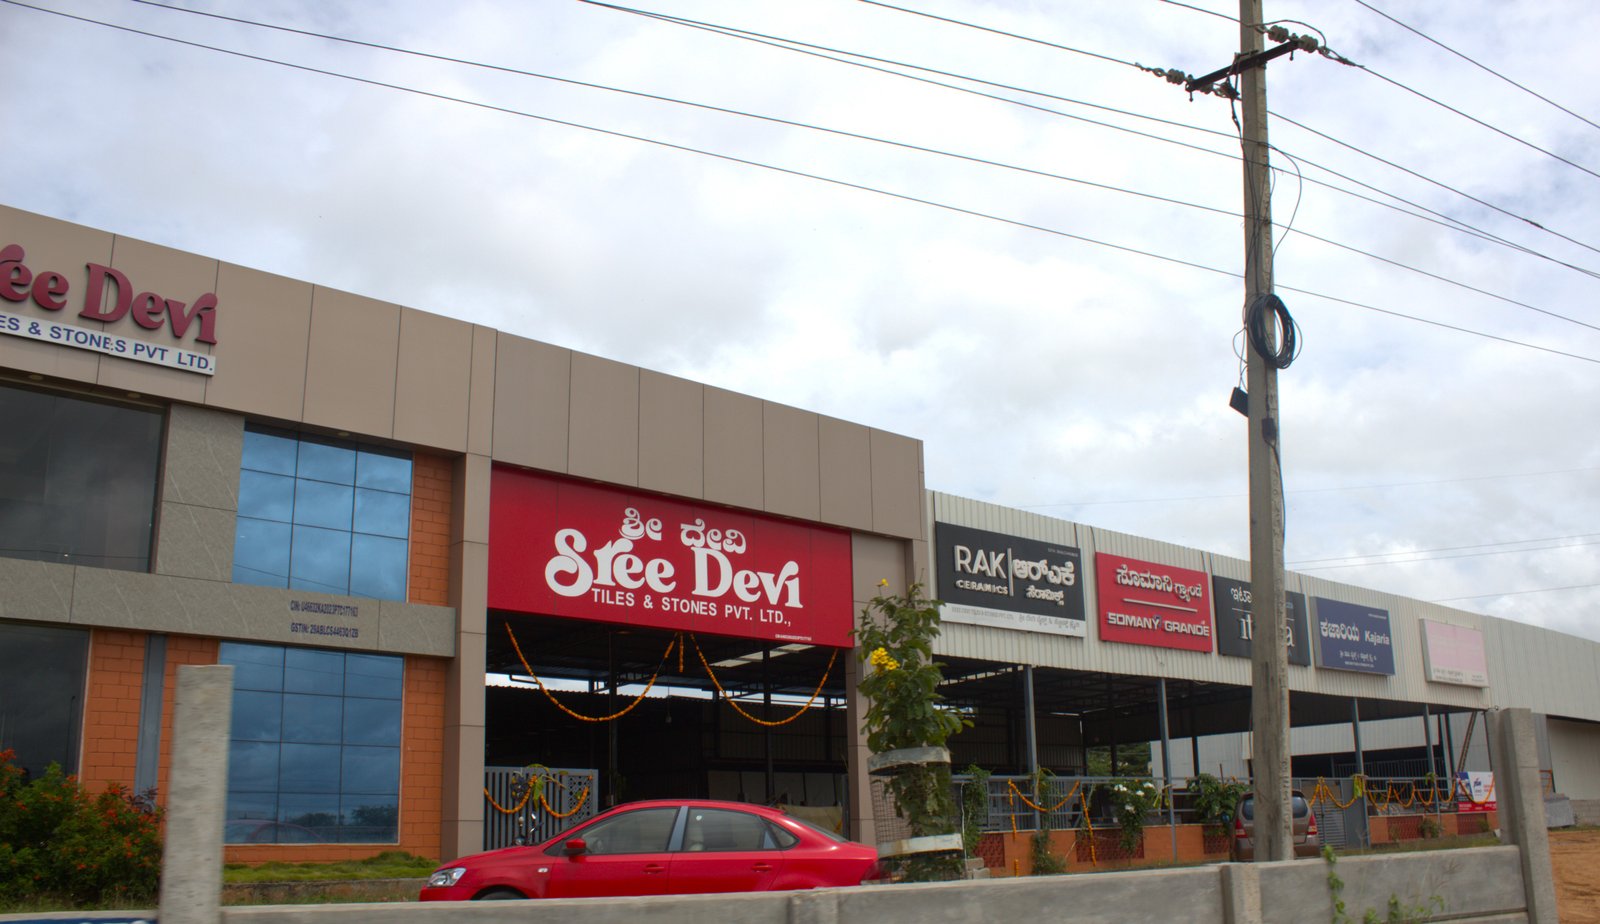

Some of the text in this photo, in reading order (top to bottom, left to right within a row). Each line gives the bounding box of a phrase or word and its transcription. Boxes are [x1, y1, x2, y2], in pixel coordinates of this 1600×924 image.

[78, 262, 218, 345] Devi
[28, 322, 41, 336] &
[50, 326, 126, 353] STONES
[133, 343, 168, 361] PVT
[177, 352, 213, 371] LTD.
[619, 507, 747, 554] ಶ್ರೀ ದೇವಿ
[545, 528, 803, 608] Sree Devi
[954, 544, 1007, 579] RAK
[591, 587, 635, 606] TILES
[644, 595, 653, 609] &
[661, 597, 717, 617] STONES
[725, 604, 753, 621] PVT.
[955, 579, 1008, 596] CERAMICS
[1108, 612, 1210, 636] SOMANY GRANDE
[1364, 630, 1390, 646] Kajaria
